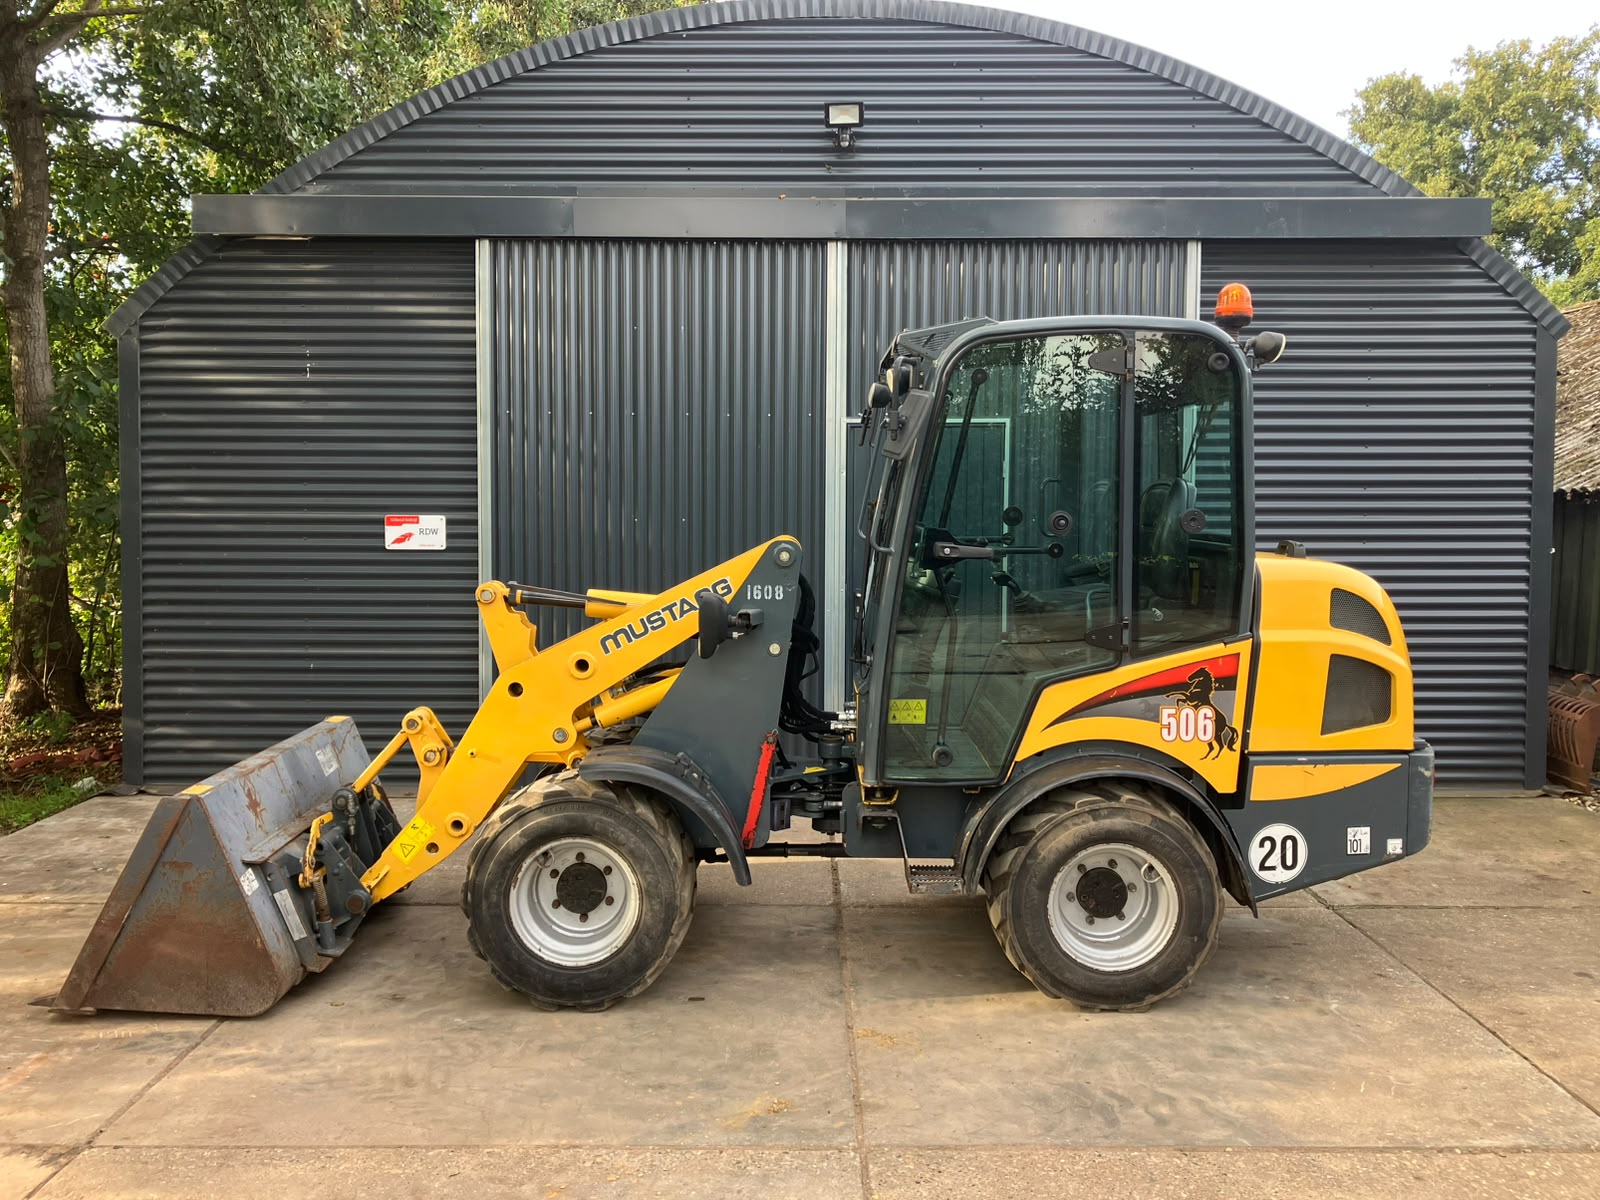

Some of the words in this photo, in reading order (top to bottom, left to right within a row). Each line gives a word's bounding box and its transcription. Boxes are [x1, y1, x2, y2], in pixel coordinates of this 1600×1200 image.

[418, 527, 439, 536] RDW
[747, 584, 784, 600] 1608
[599, 578, 733, 655] MUSTAG
[1160, 706, 1215, 743] 506
[1258, 835, 1299, 872] 20
[1348, 838, 1362, 853] 101
